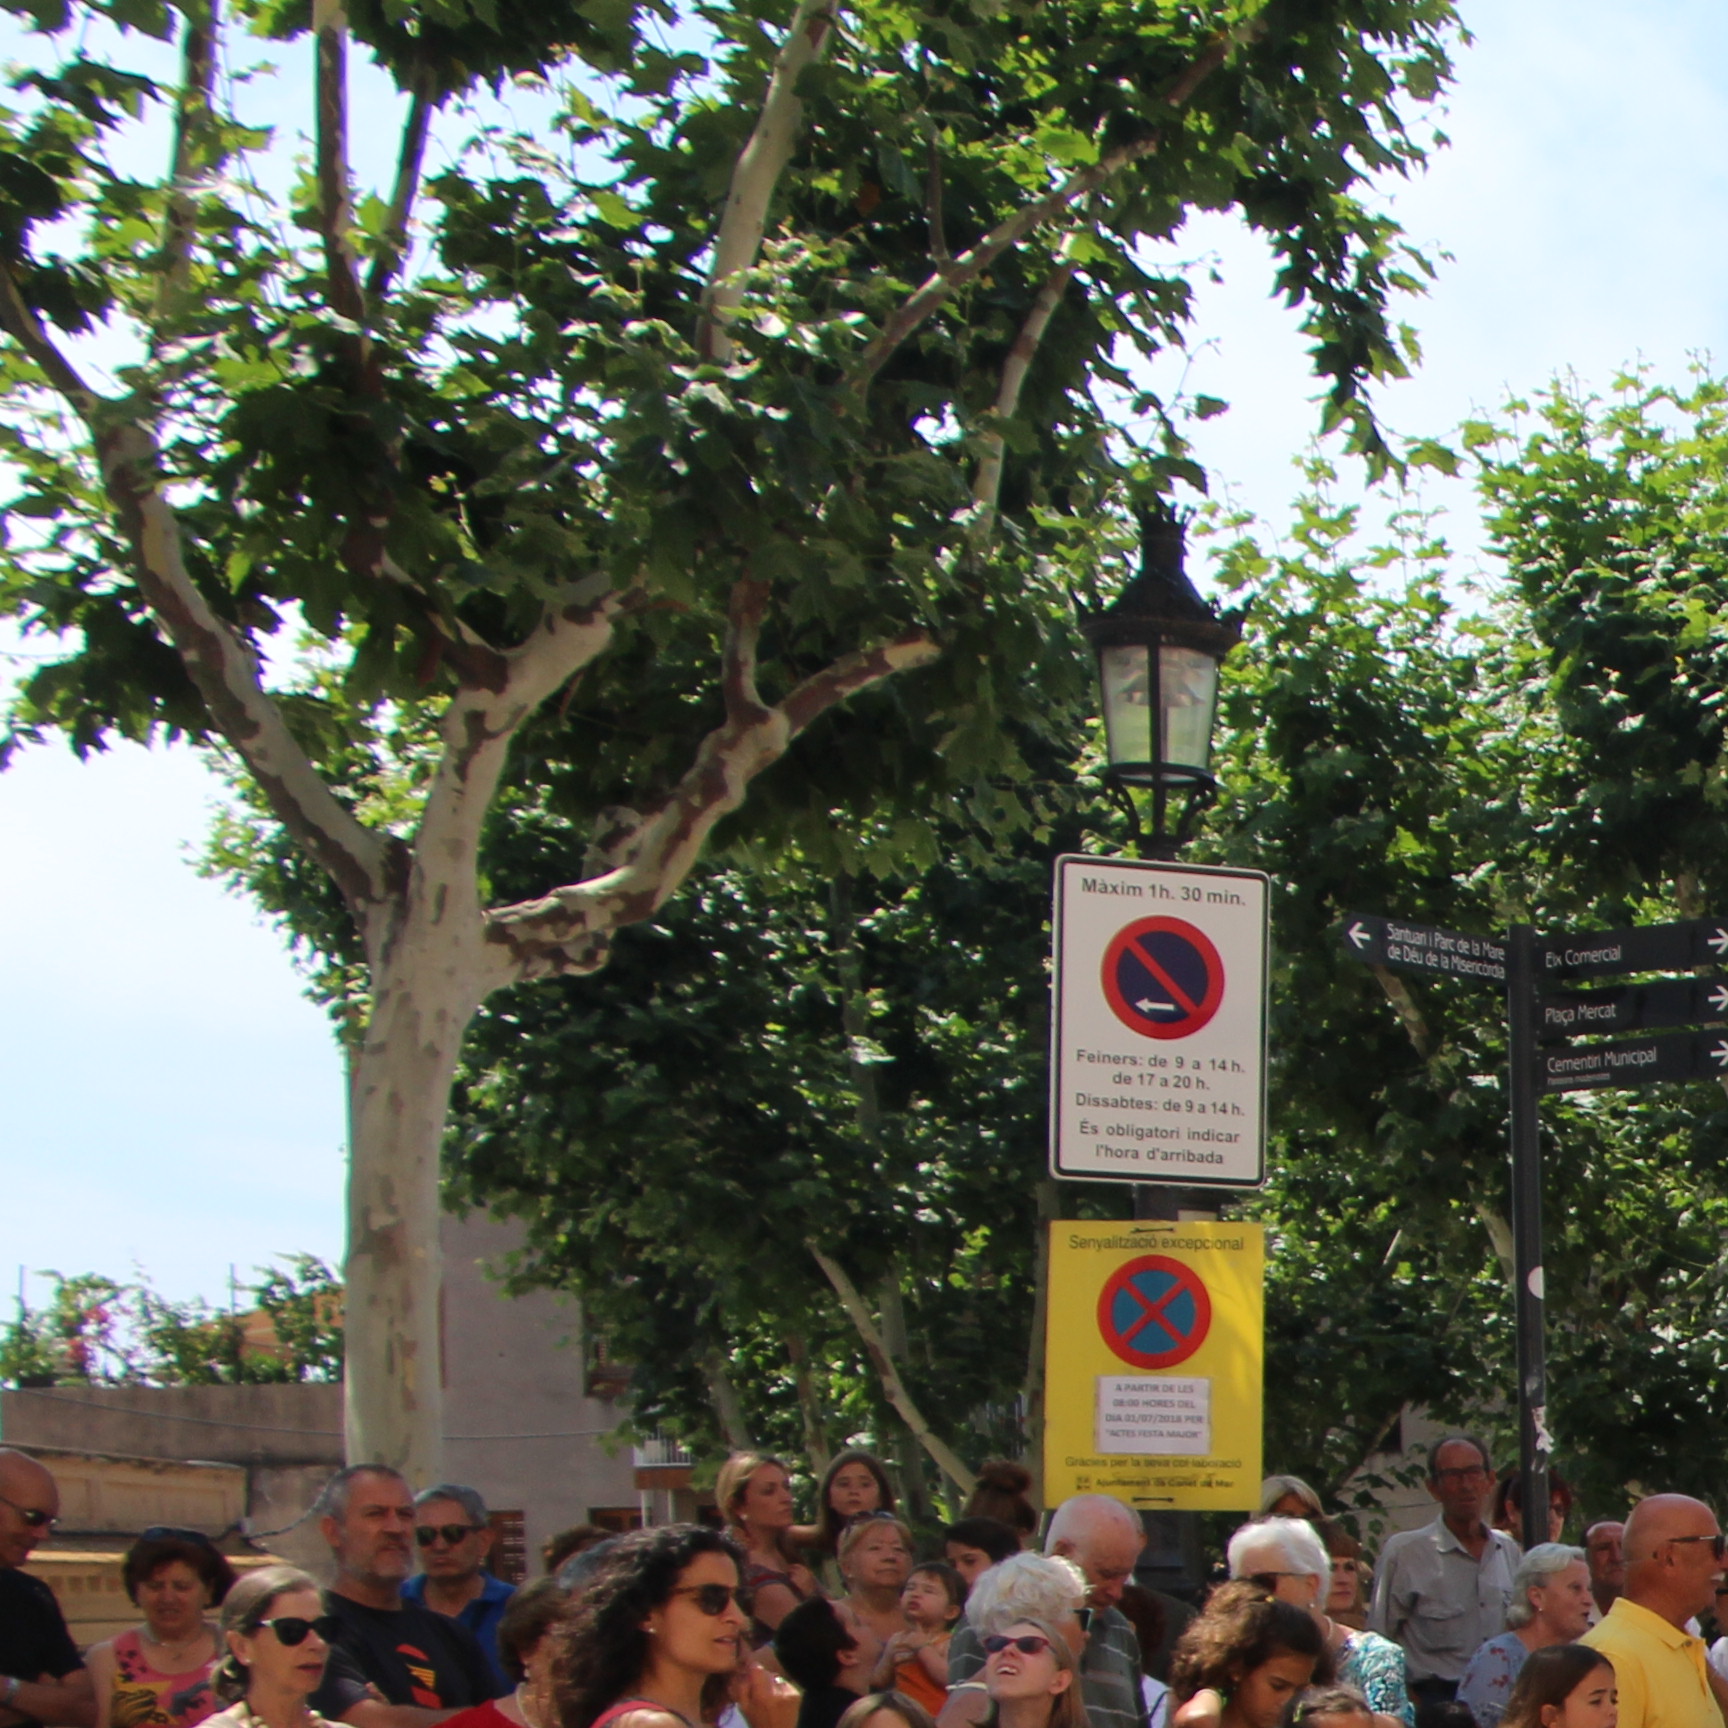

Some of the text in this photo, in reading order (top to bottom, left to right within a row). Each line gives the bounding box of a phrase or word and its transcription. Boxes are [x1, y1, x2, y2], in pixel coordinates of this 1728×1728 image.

[1082, 877, 1246, 905] Màxim 1h. 30 min.
[1387, 923, 1426, 945] Santuari
[1434, 932, 1455, 951] Parc
[1457, 939, 1469, 954] de
[1472, 940, 1480, 956] la
[1482, 942, 1505, 961] Mare
[1545, 945, 1621, 968] Eix Comercial
[1545, 1003, 1616, 1026] Plaça Mercat
[1076, 1049, 1245, 1072] Feiners: de 9 a 14 h.
[1548, 1047, 1656, 1072] Cementiri Municipal
[1113, 1072, 1210, 1090] de 17 a 20 h.
[1076, 1093, 1245, 1116] Dissabtes: de 9 a 14 h.
[1079, 1118, 1240, 1143] És obligatori indicar
[1096, 1145, 1224, 1164] l'hora d'arribada
